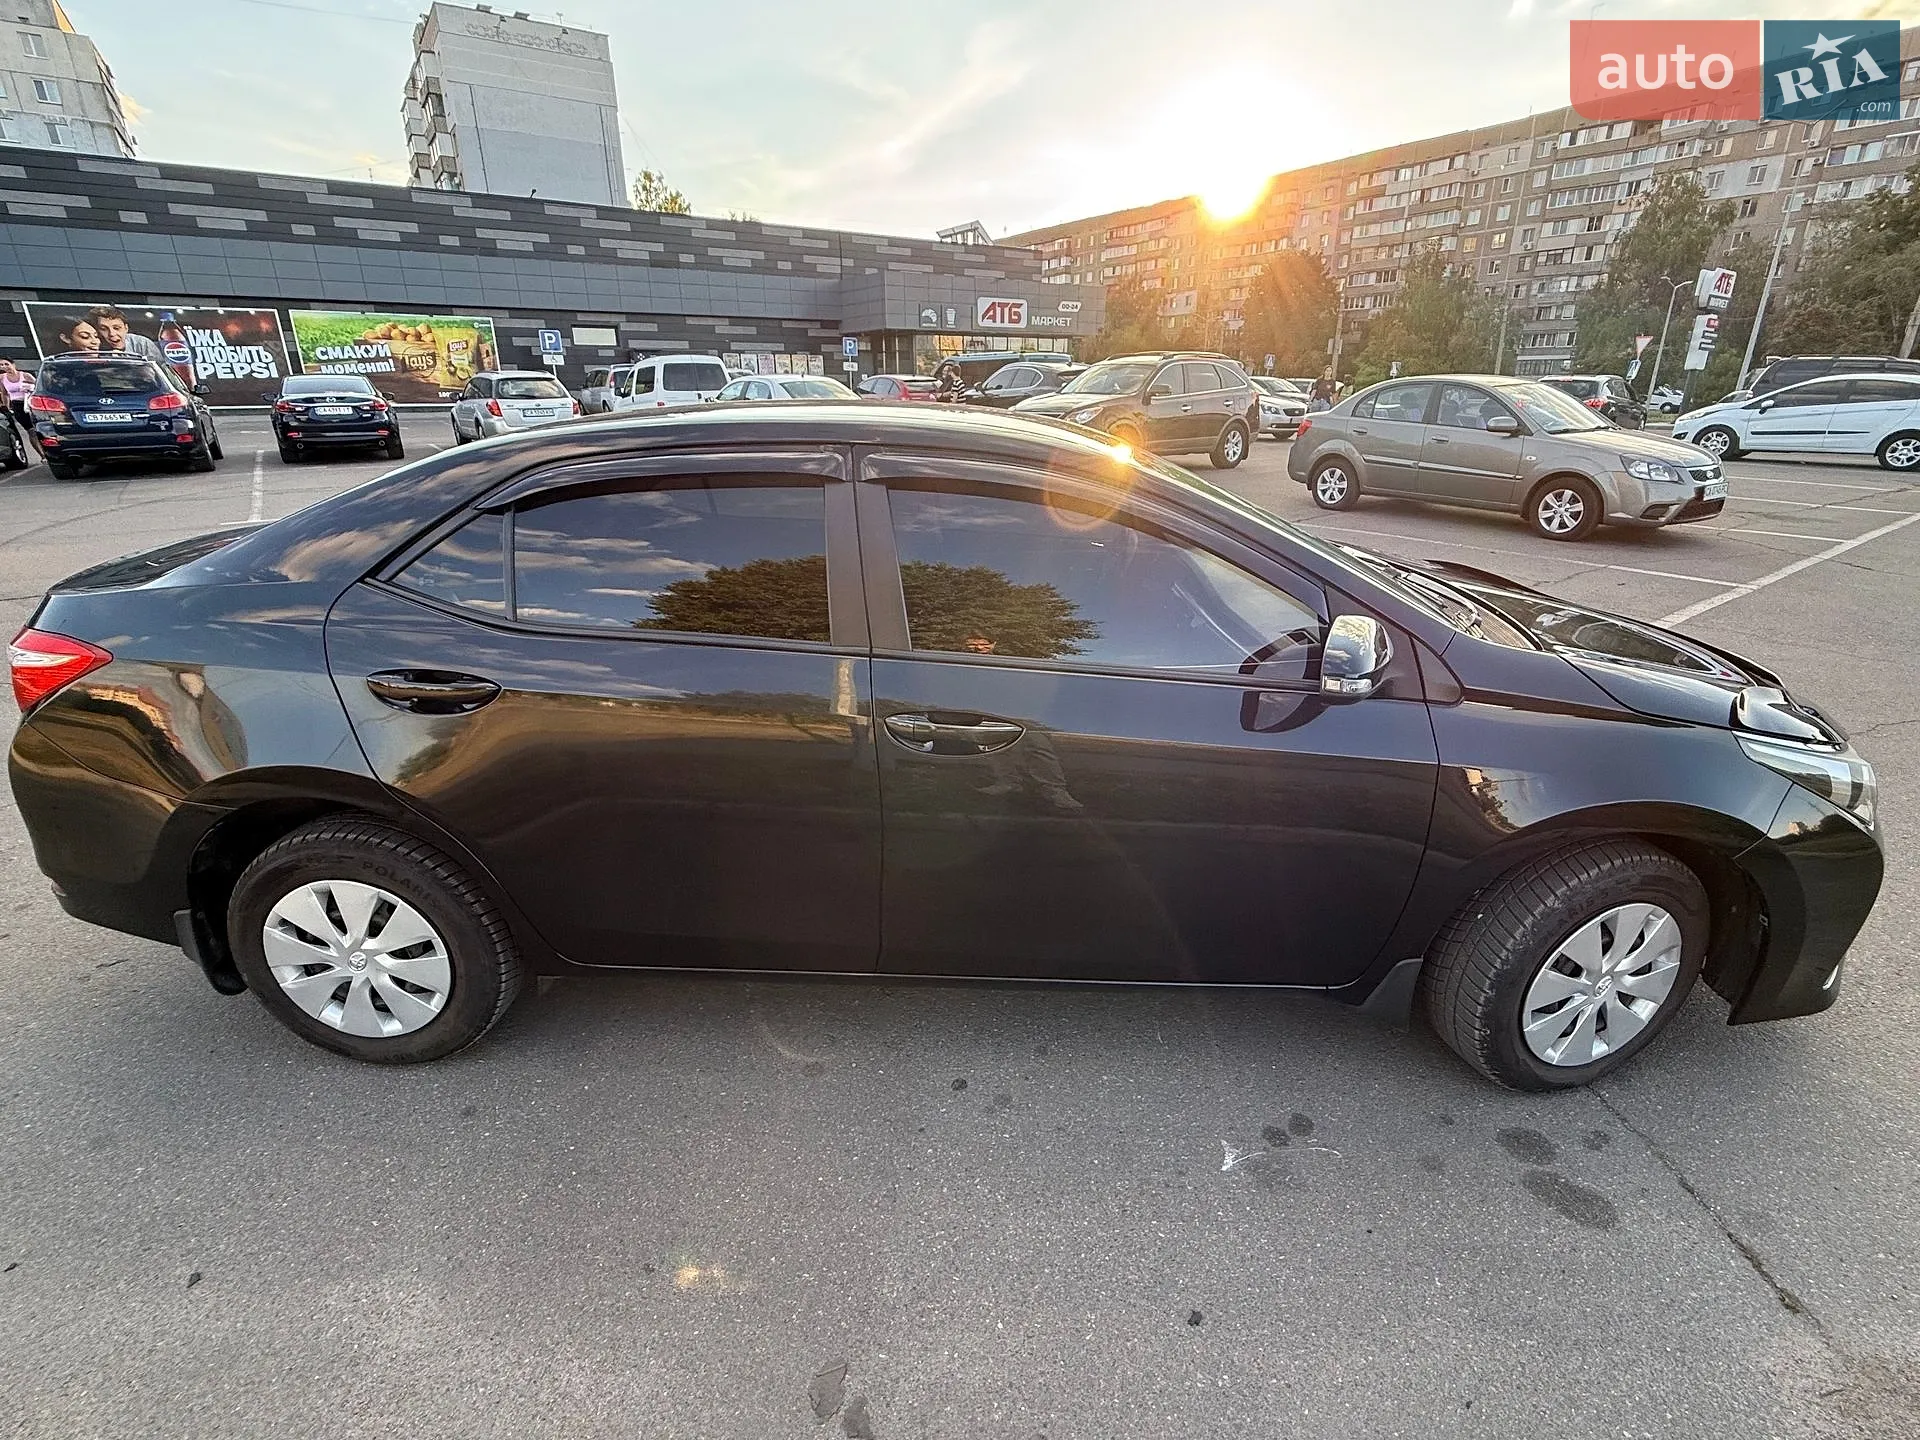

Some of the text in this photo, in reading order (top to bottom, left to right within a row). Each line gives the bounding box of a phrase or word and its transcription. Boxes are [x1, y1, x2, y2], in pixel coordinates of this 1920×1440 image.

[981, 301, 1024, 324] АТБ
[1031, 315, 1072, 327] МАРКЕТ
[183, 326, 227, 347] ЇЖА
[543, 332, 556, 349] P
[195, 346, 273, 363] ЛЮБИТЬ
[315, 342, 392, 361] СМАКУЙ
[846, 340, 855, 353] P
[196, 362, 279, 379] PEPSI
[320, 359, 396, 375] момент!
